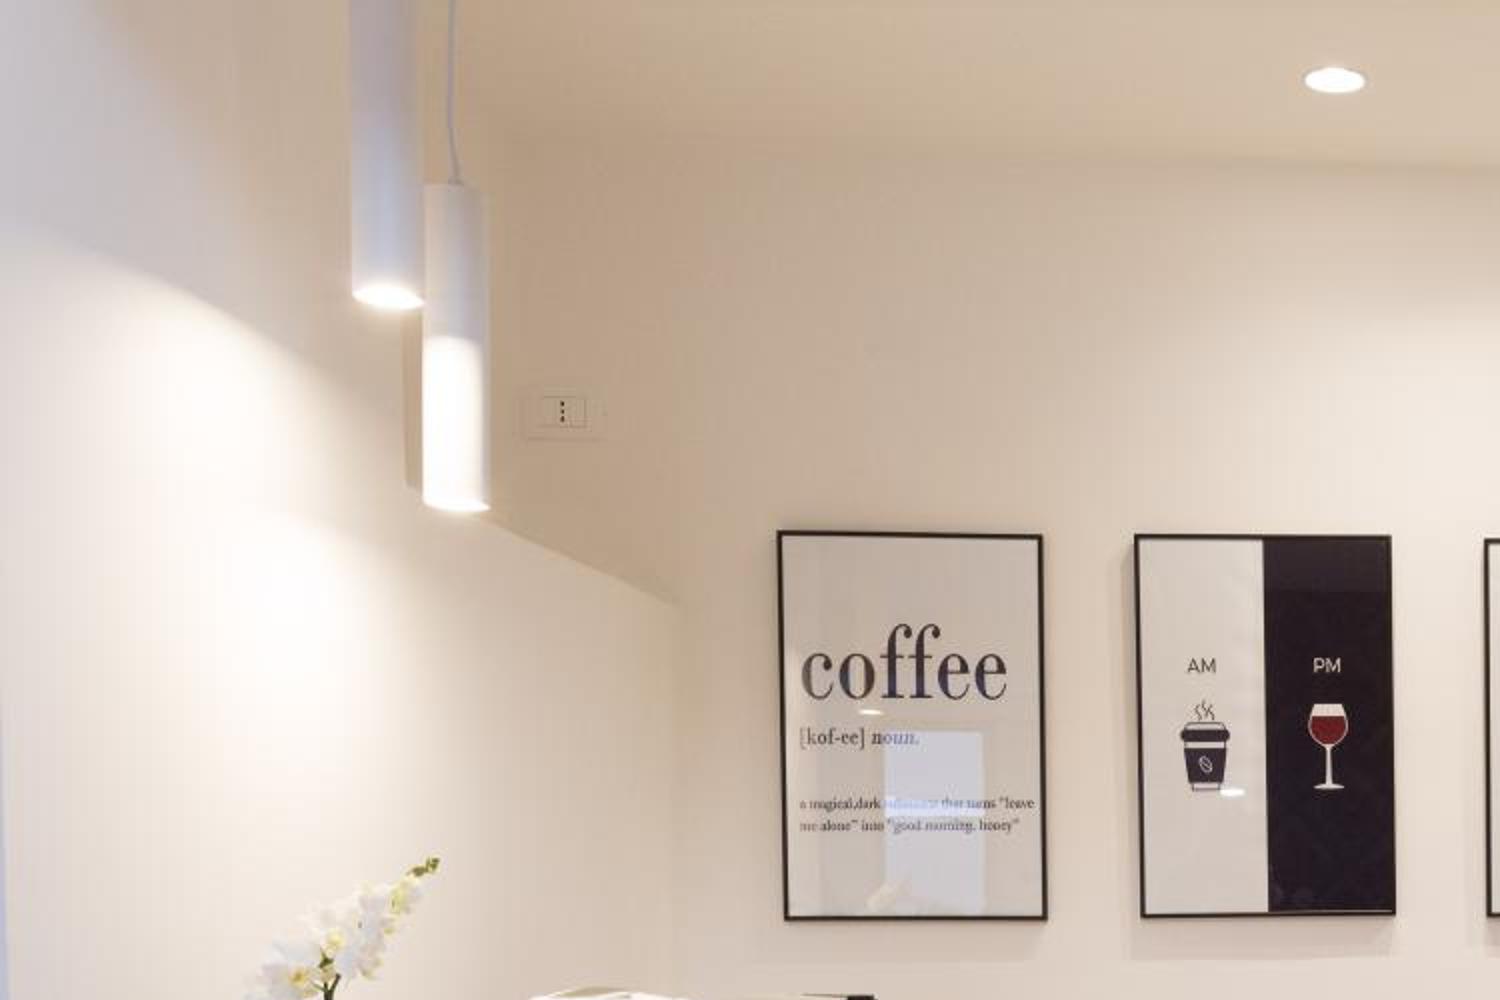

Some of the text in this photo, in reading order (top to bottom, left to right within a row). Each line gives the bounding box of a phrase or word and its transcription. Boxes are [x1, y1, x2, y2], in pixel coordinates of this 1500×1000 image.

[801, 623, 1008, 700] coffee
[1187, 657, 1217, 673] AM
[1313, 657, 1342, 673] PM
[800, 727, 920, 749] [kof-ee] noun.
